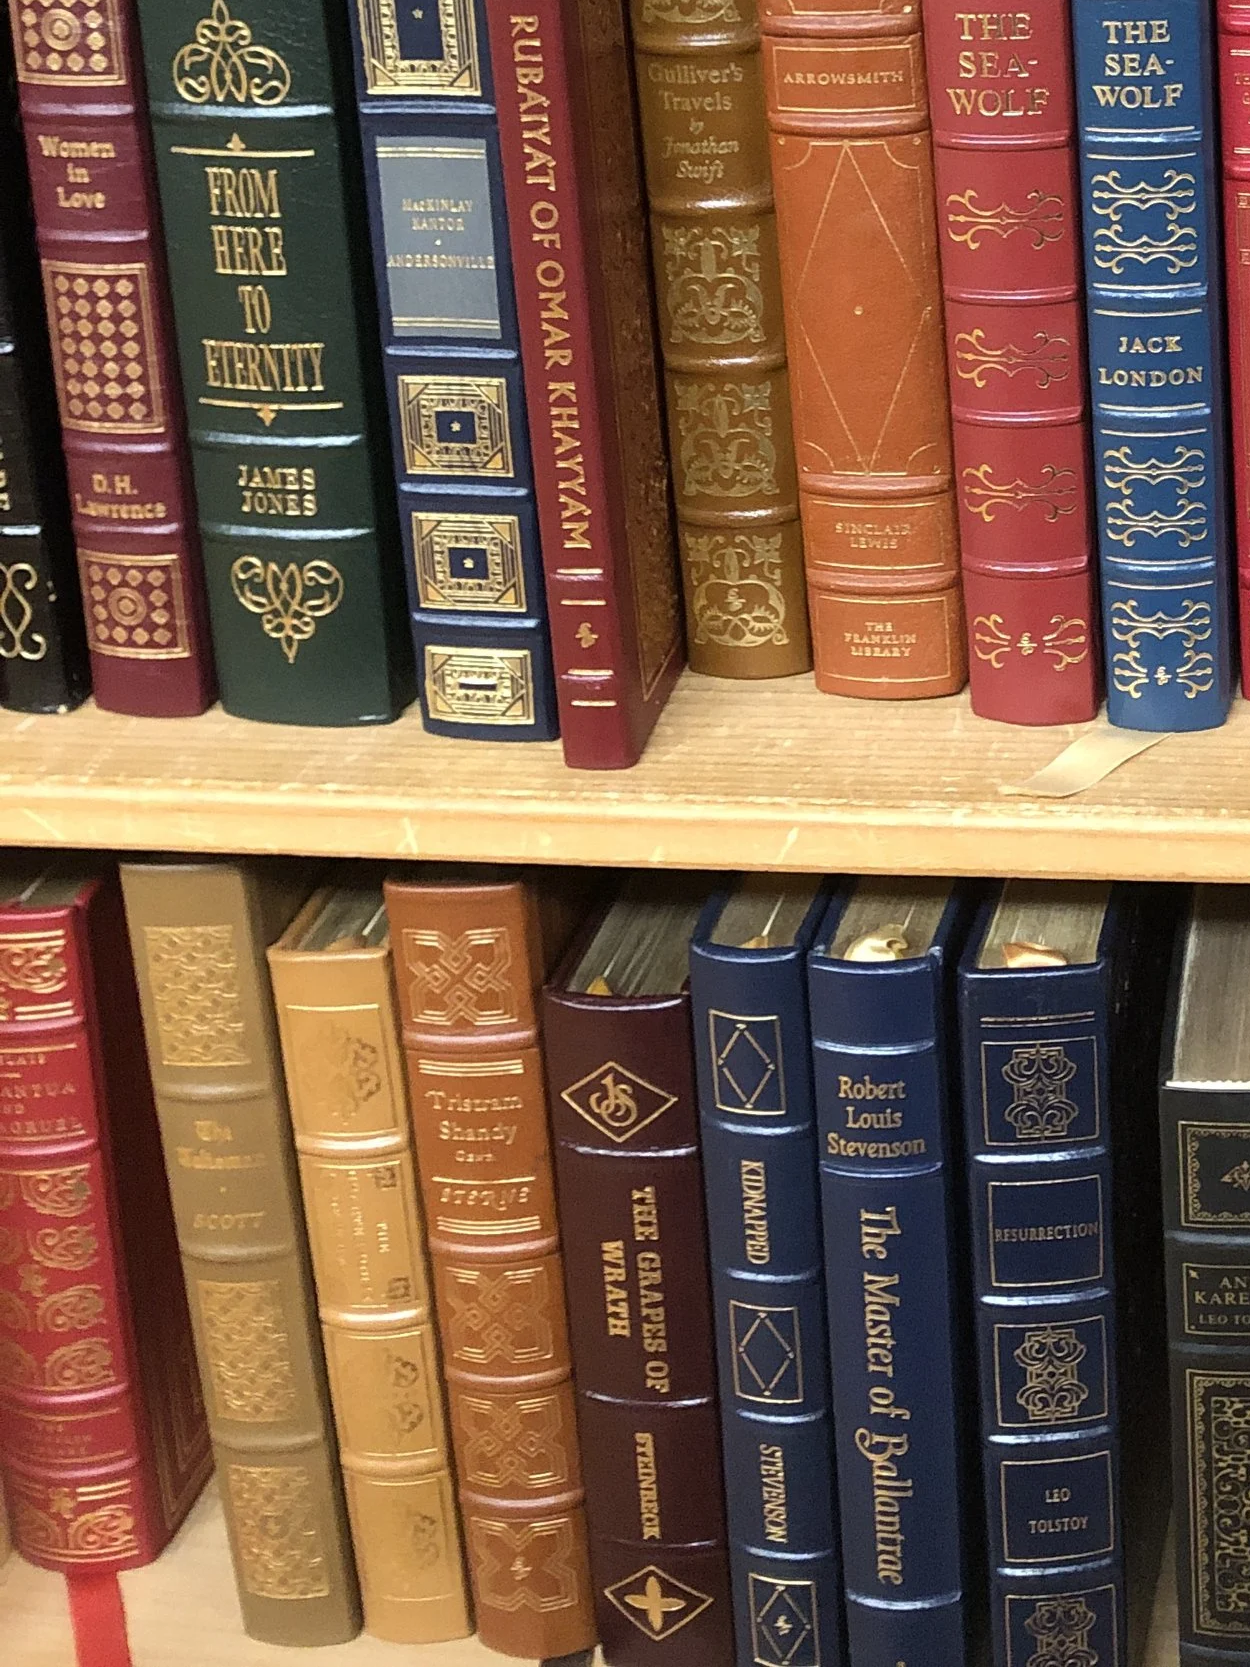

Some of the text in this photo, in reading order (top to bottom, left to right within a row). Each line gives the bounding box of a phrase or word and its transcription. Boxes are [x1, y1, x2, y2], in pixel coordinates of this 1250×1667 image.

[955, 13, 1033, 41] THE
[1102, 20, 1171, 45] THE
[958, 51, 1038, 78] SEA-
[1104, 53, 1175, 77] SEA-
[783, 70, 904, 85] ARROWSMITH
[659, 91, 733, 111] Travels
[946, 88, 1050, 117] WOLF
[1092, 83, 1183, 109] WOLF
[38, 134, 116, 158] Women
[662, 137, 740, 159] Jonathan
[67, 163, 90, 183] in
[676, 160, 724, 183] Swift
[57, 186, 106, 209] Love
[204, 166, 281, 218] FROM
[211, 224, 288, 276] HERE
[530, 200, 573, 369] OF OMAR
[237, 284, 272, 334] TO
[1118, 336, 1183, 354] JACK
[200, 339, 325, 392] ETERNITY
[1098, 366, 1205, 387] LONDON
[238, 464, 316, 491] JAMES
[75, 493, 167, 519] Lawrence
[241, 490, 318, 517] JONES
[850, 538, 898, 550] LEWIS
[865, 622, 893, 632] THE
[838, 1075, 906, 1100] Robert
[845, 1106, 903, 1129] Louis
[439, 1120, 517, 1145] Shandy
[827, 1132, 926, 1158] Stevenson
[193, 1210, 266, 1230] SCOTT
[741, 1159, 771, 1265] KIDNAPPED
[995, 1222, 1099, 1243] RESURRECTION
[601, 1240, 631, 1337] WRATH
[632, 1186, 670, 1393] THE GRAPES OF
[1199, 1314, 1227, 1325] LEO
[854, 1206, 913, 1586] The Master of Ballantrae
[635, 1432, 662, 1540] STEINBECK
[759, 1443, 789, 1544] STEVENSON
[1045, 1487, 1071, 1503] LEO
[1028, 1516, 1089, 1534] TOLSTOY
